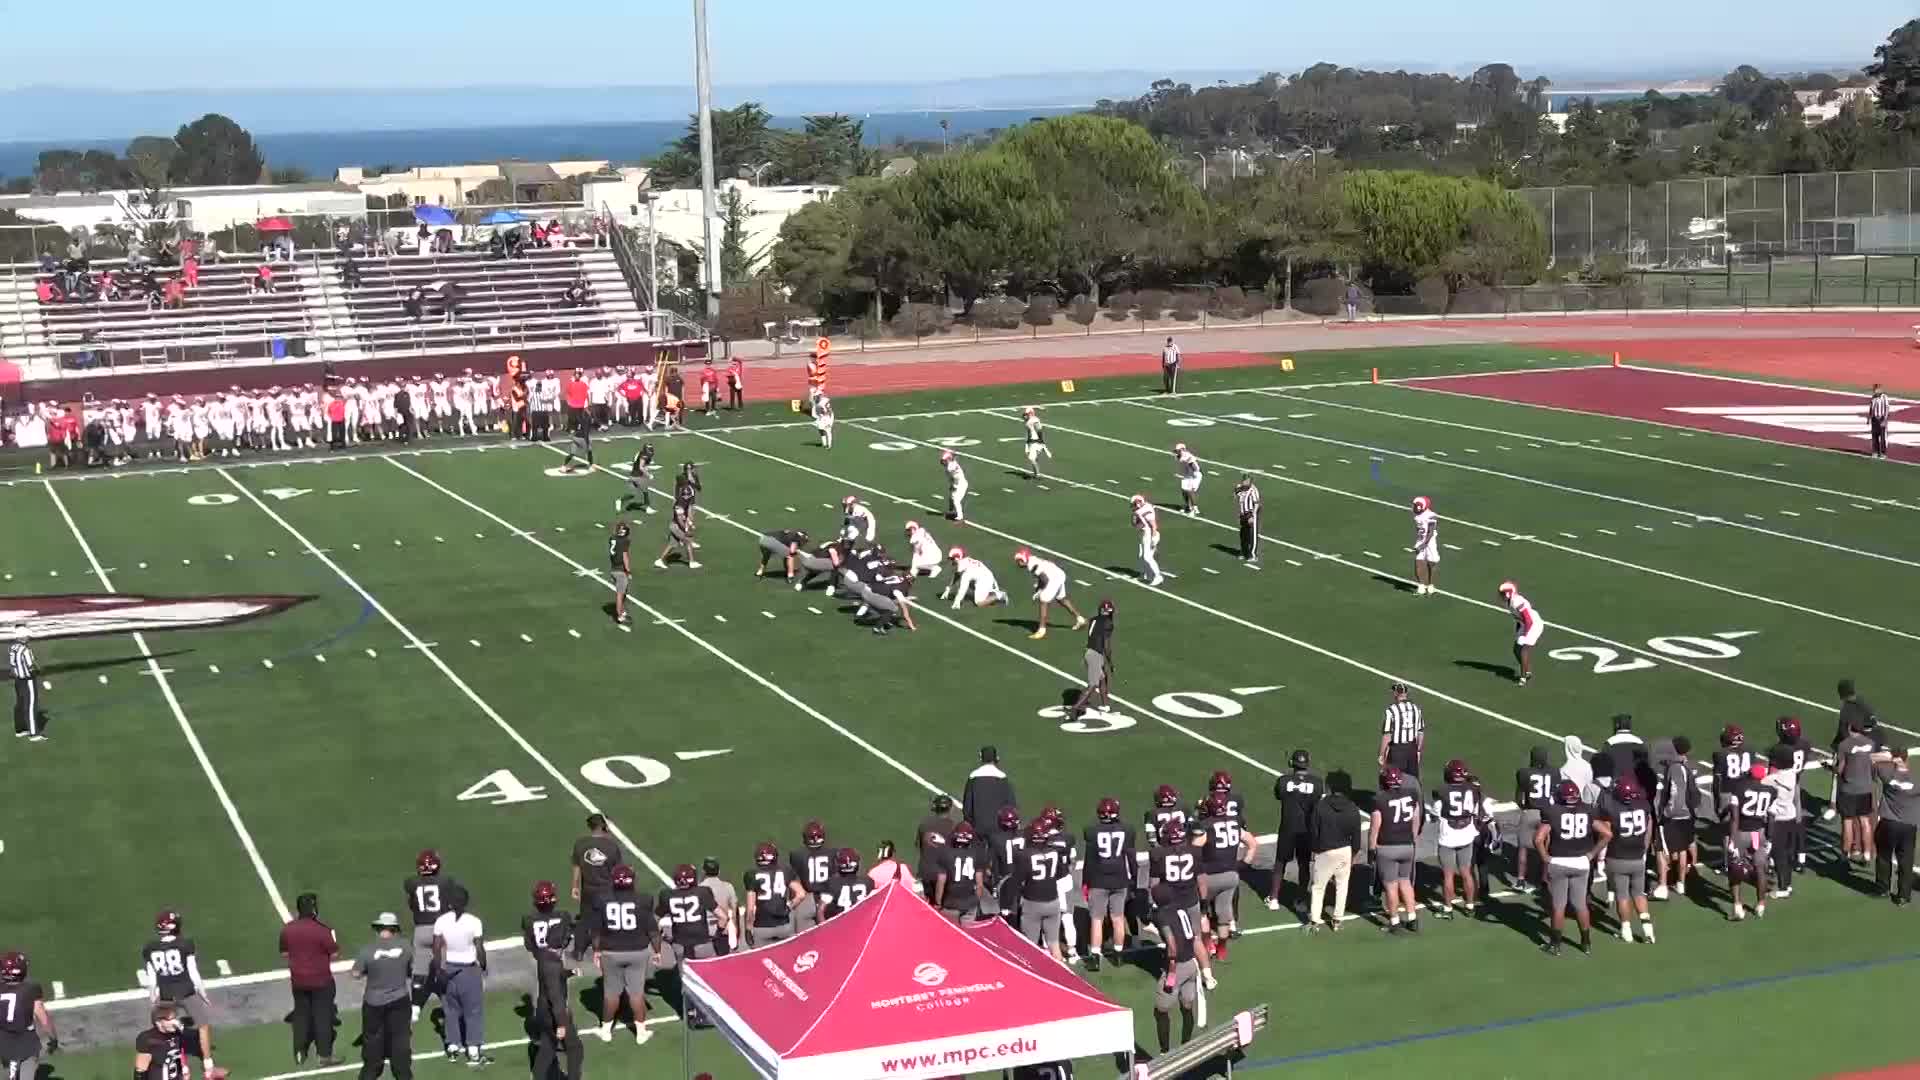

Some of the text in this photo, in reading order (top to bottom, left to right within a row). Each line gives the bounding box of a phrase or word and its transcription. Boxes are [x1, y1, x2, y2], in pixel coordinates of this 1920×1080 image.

[1548, 636, 1741, 673] 20
[1726, 752, 1751, 778] 84
[456, 755, 671, 804] 40
[1529, 774, 1552, 798] 31
[1388, 797, 1413, 823] 75
[1449, 791, 1475, 816] 54
[1742, 790, 1771, 816] 20
[1213, 820, 1239, 848] 56
[1560, 813, 1588, 838] 98
[1620, 811, 1646, 836] 59
[1097, 831, 1125, 857] 97
[807, 856, 829, 883] 16
[954, 857, 975, 881] 14
[1031, 851, 1058, 880] 57
[1165, 853, 1194, 881] 62
[415, 884, 441, 912] 13
[755, 871, 786, 900] 34
[606, 902, 636, 930] 96
[669, 896, 701, 923] 52
[533, 918, 561, 948] 8
[151, 949, 184, 977] 88
[881, 1037, 1038, 1073] www.mpc.edu
